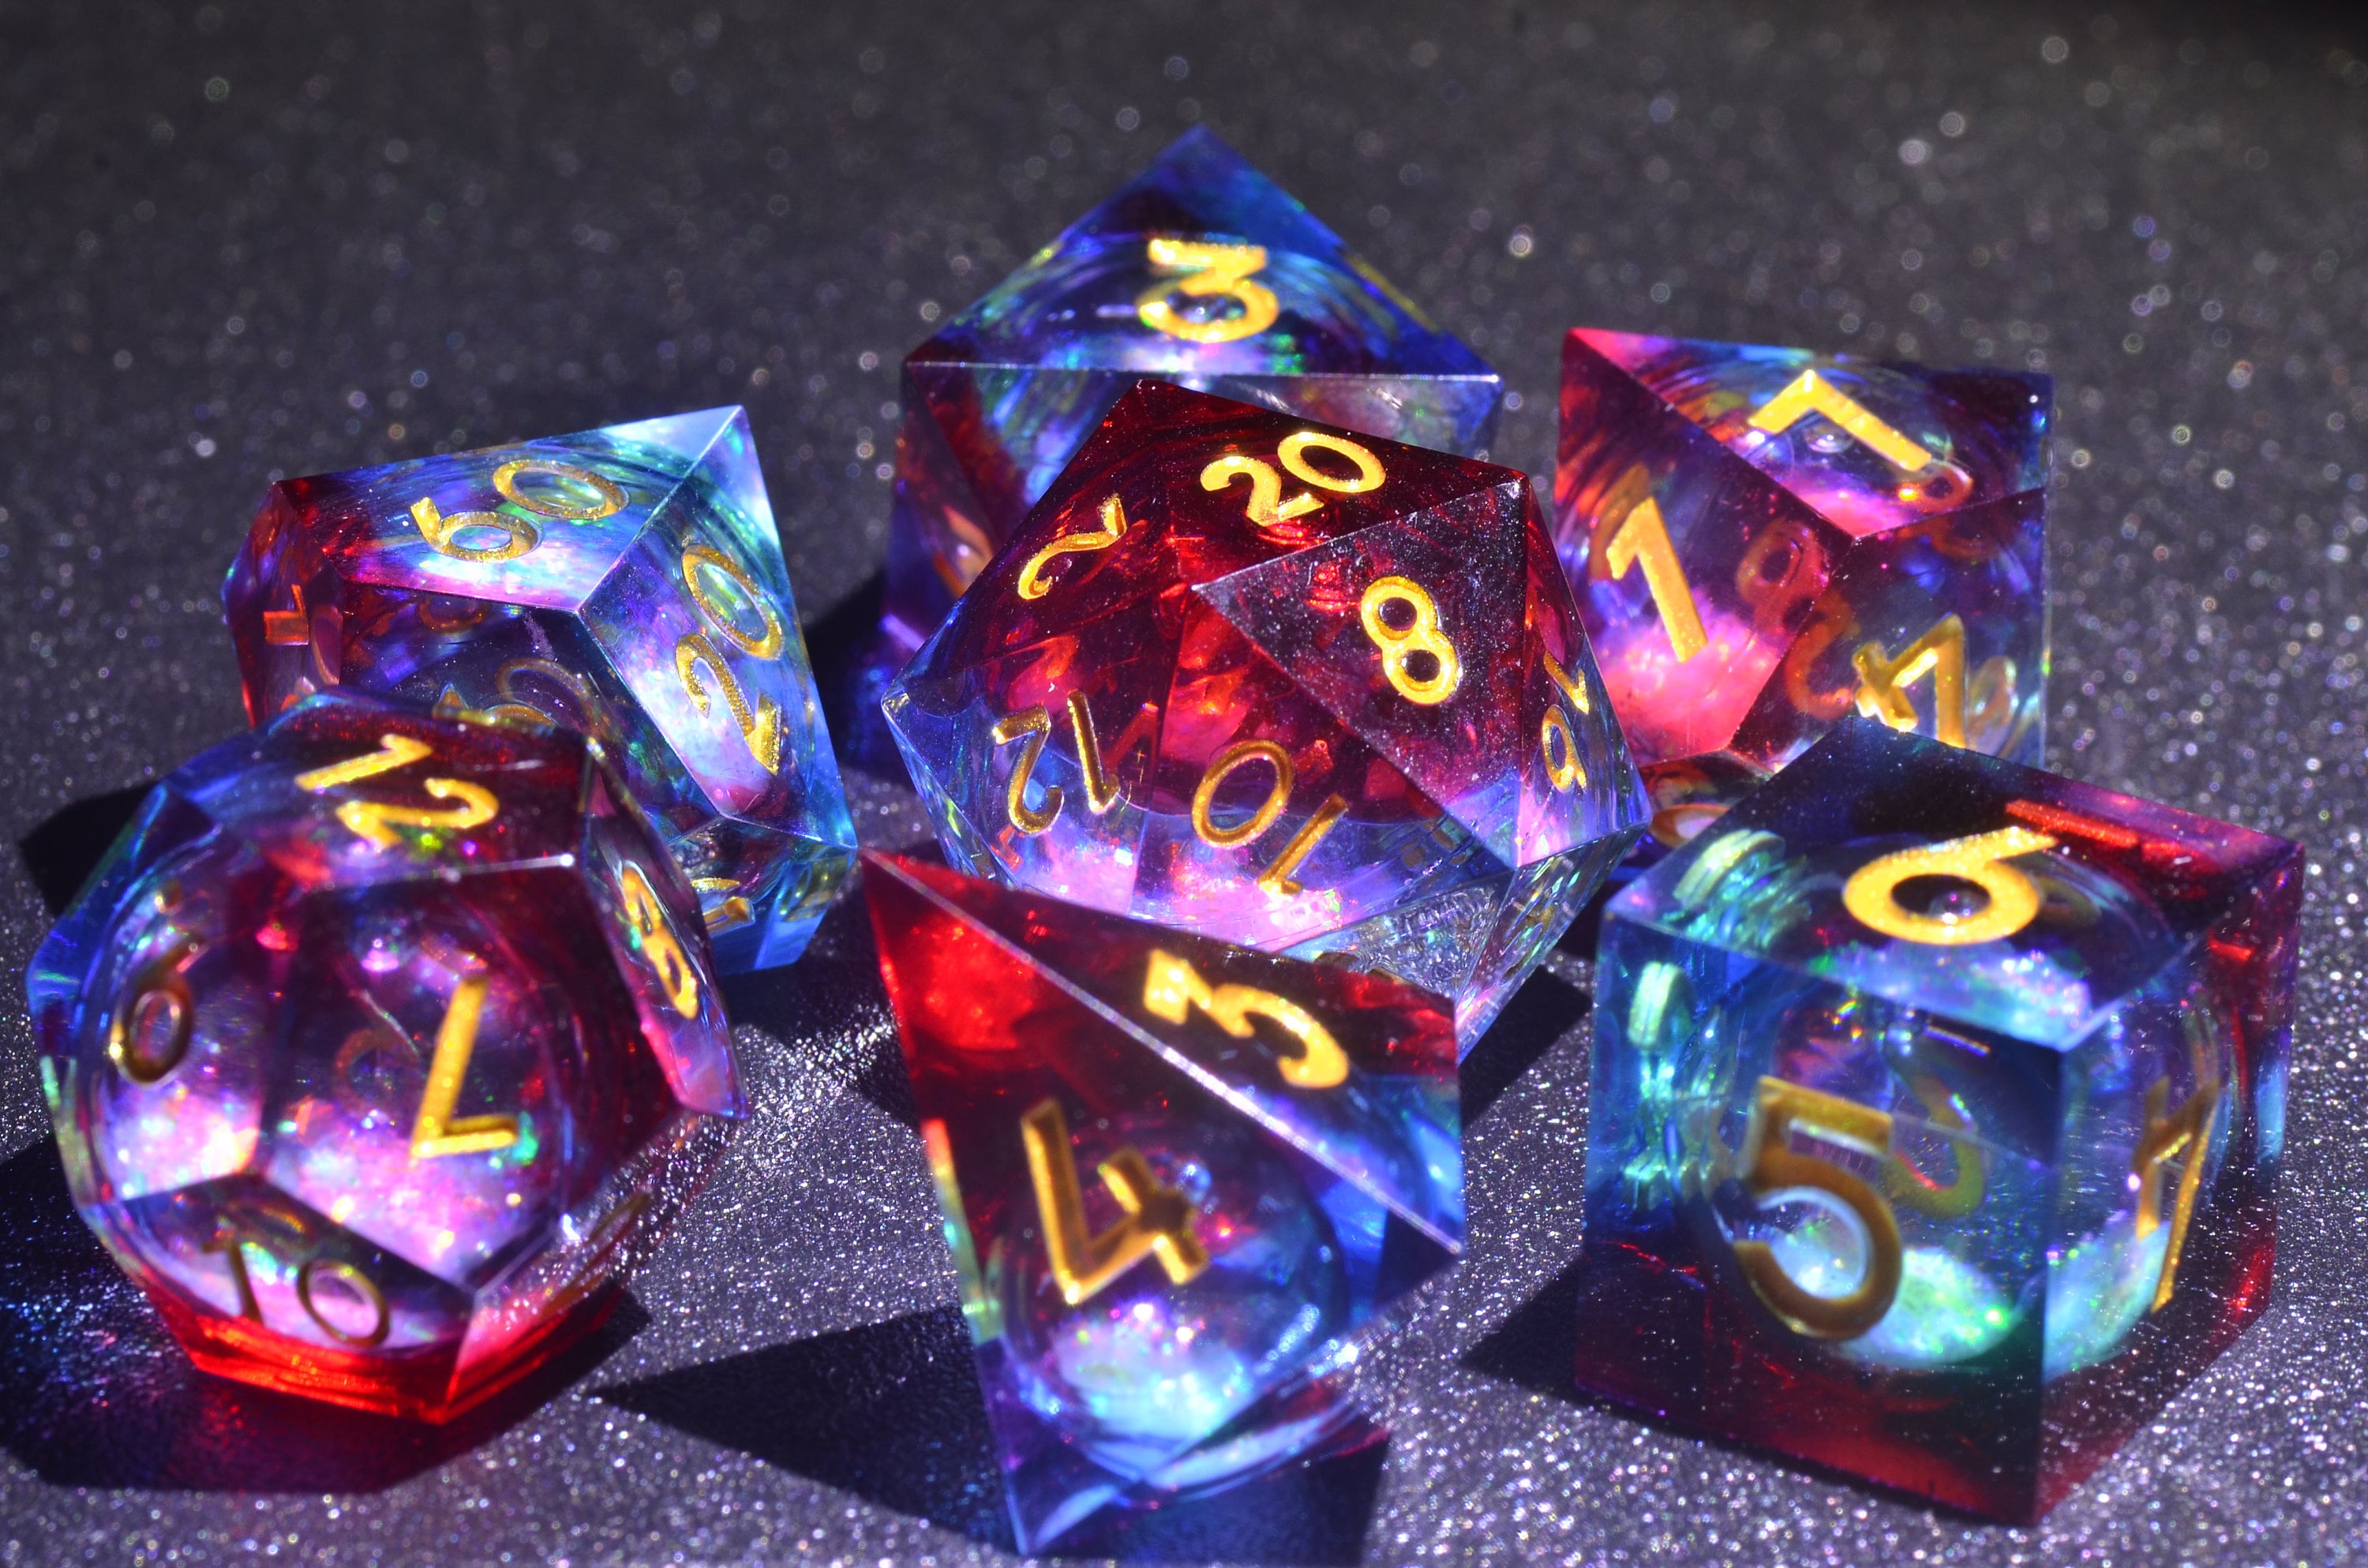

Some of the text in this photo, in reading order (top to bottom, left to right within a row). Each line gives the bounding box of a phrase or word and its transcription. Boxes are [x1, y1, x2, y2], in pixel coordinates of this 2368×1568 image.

[1137, 238, 1280, 344] 3
[1200, 431, 1387, 526] 20
[1017, 493, 1129, 600] 2
[1606, 496, 1709, 663] 1
[1360, 575, 1463, 705] 8
[294, 733, 500, 854] 12
[1842, 825, 2059, 945] 6
[1020, 1098, 1208, 1308] 4
[1733, 1075, 1904, 1342] 5
